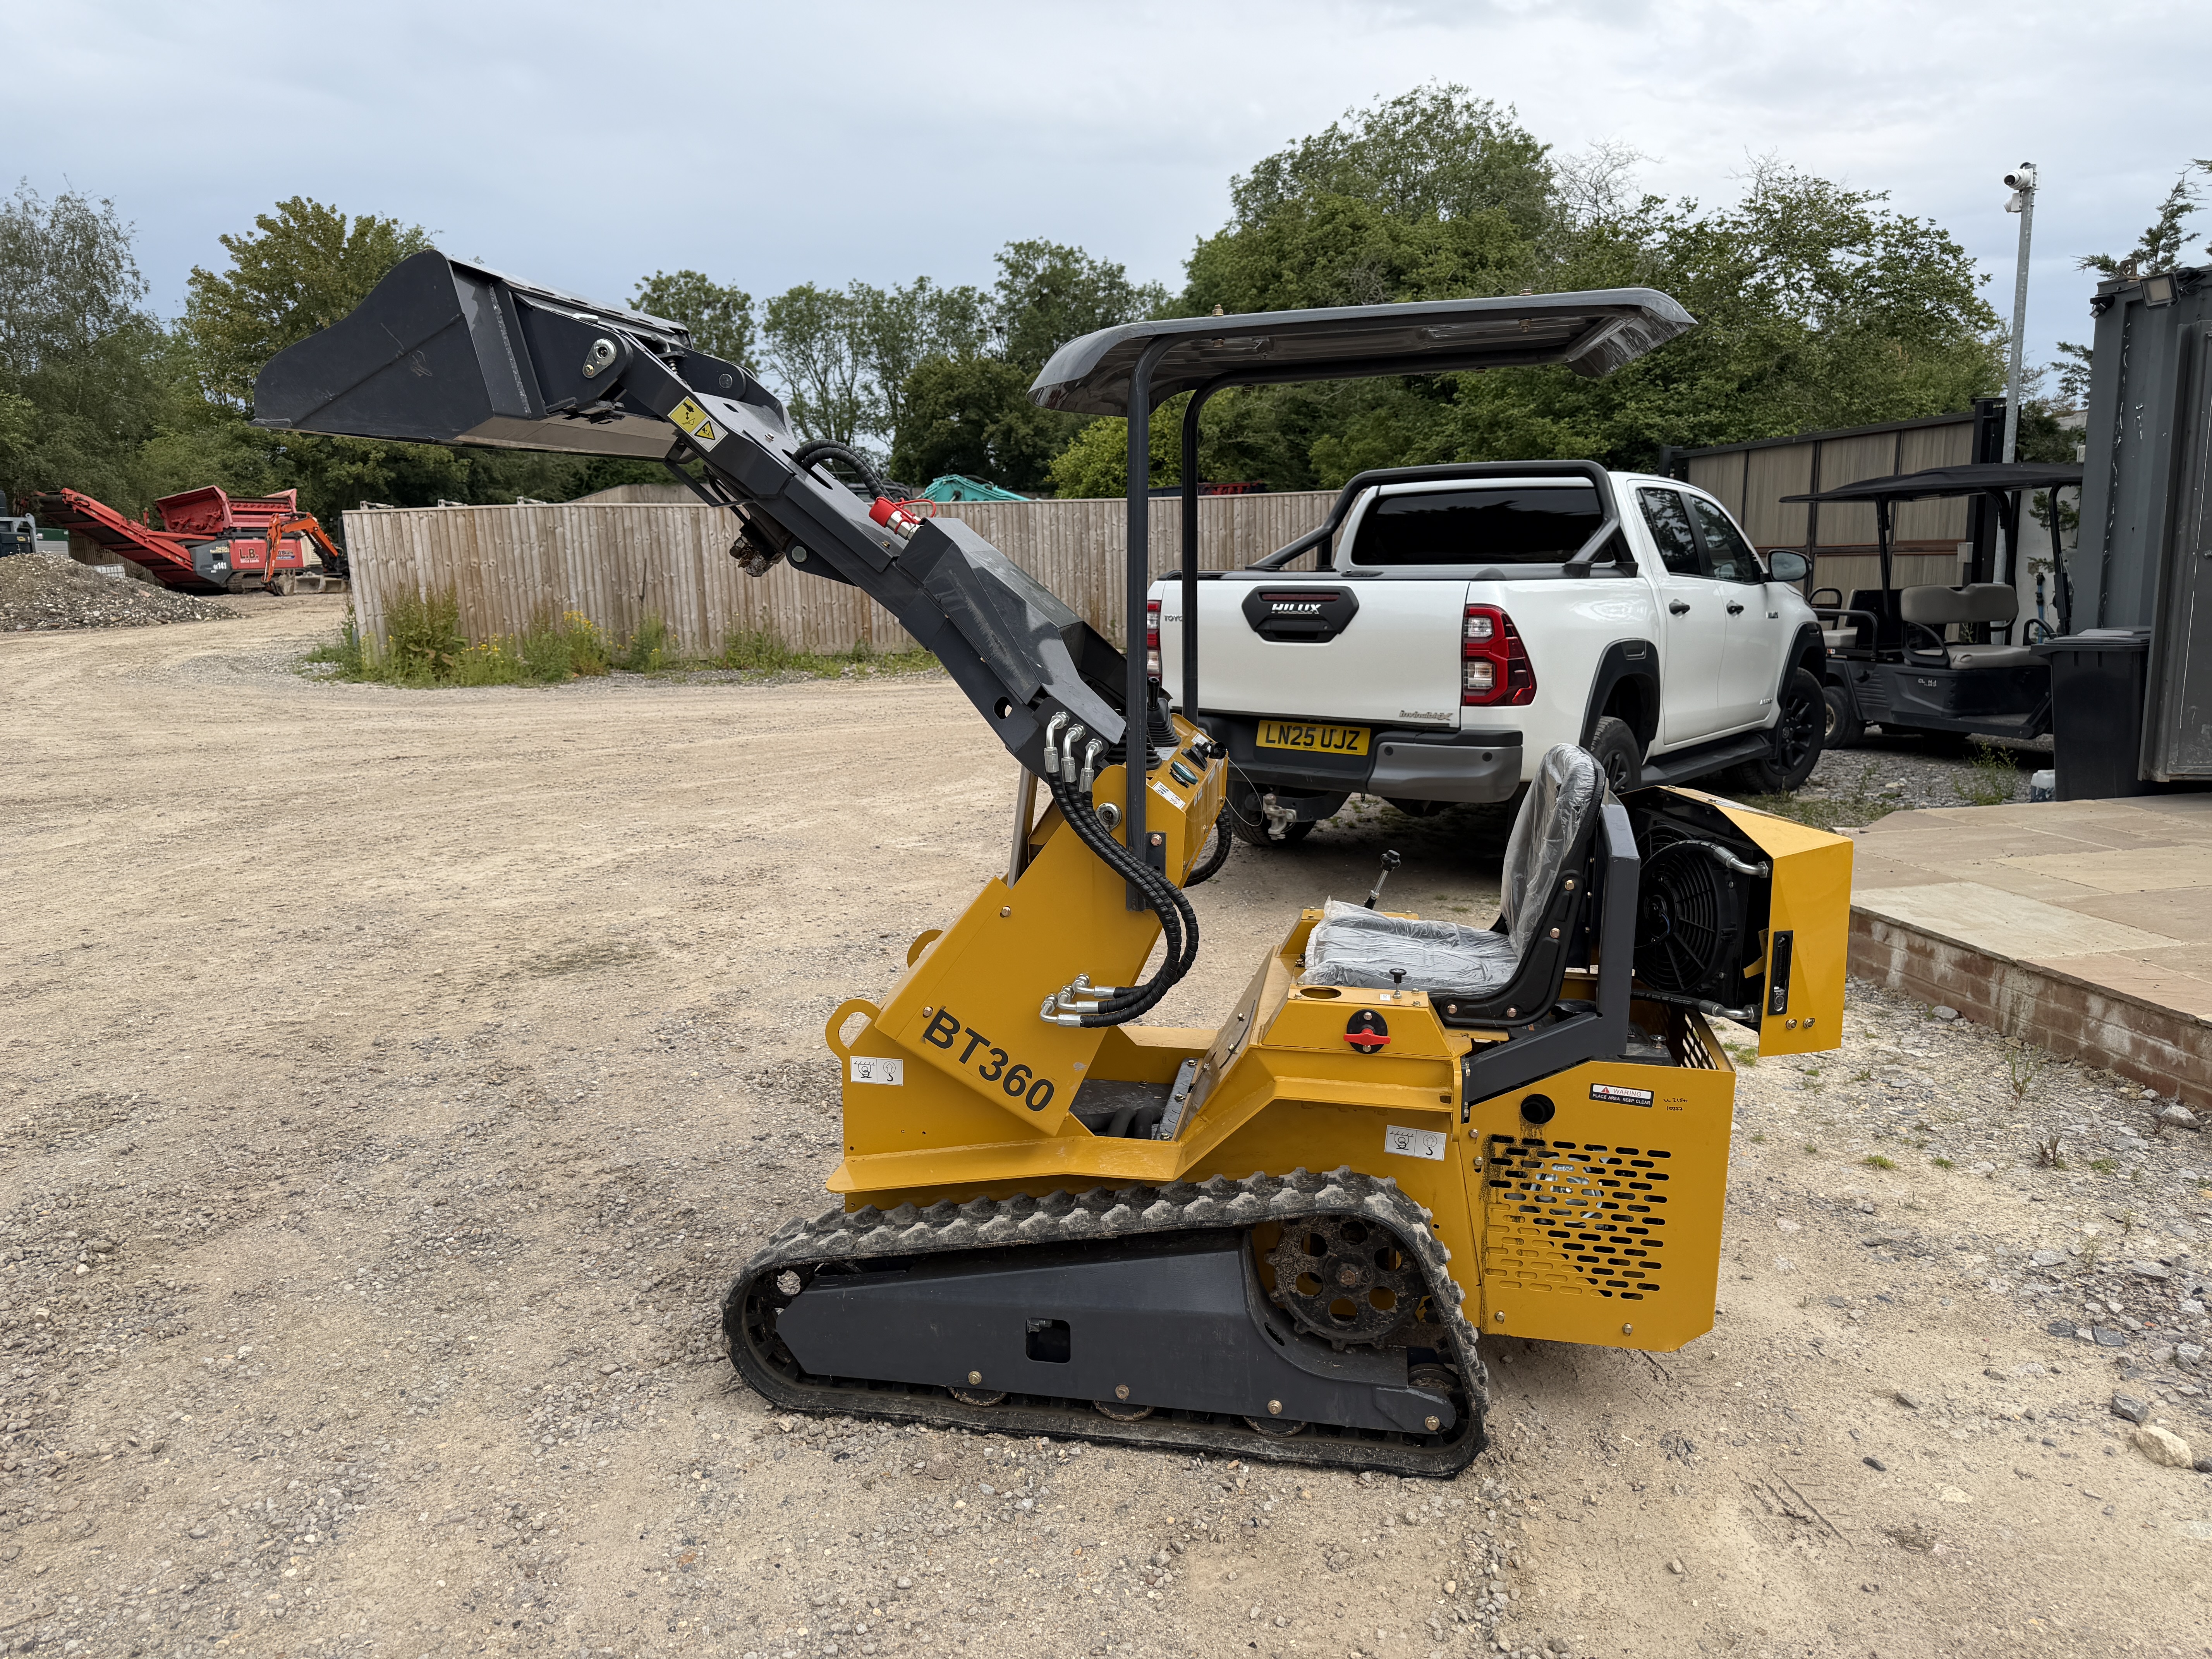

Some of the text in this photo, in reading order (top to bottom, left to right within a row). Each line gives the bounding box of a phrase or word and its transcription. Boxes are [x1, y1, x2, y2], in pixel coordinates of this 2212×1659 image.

[239, 548, 259, 558] L.B.
[1271, 603, 1321, 614] HILUX
[1265, 724, 1360, 750] LN25 UJZ
[923, 1009, 1054, 1111] BT360
[1613, 1088, 1642, 1097] WARING
